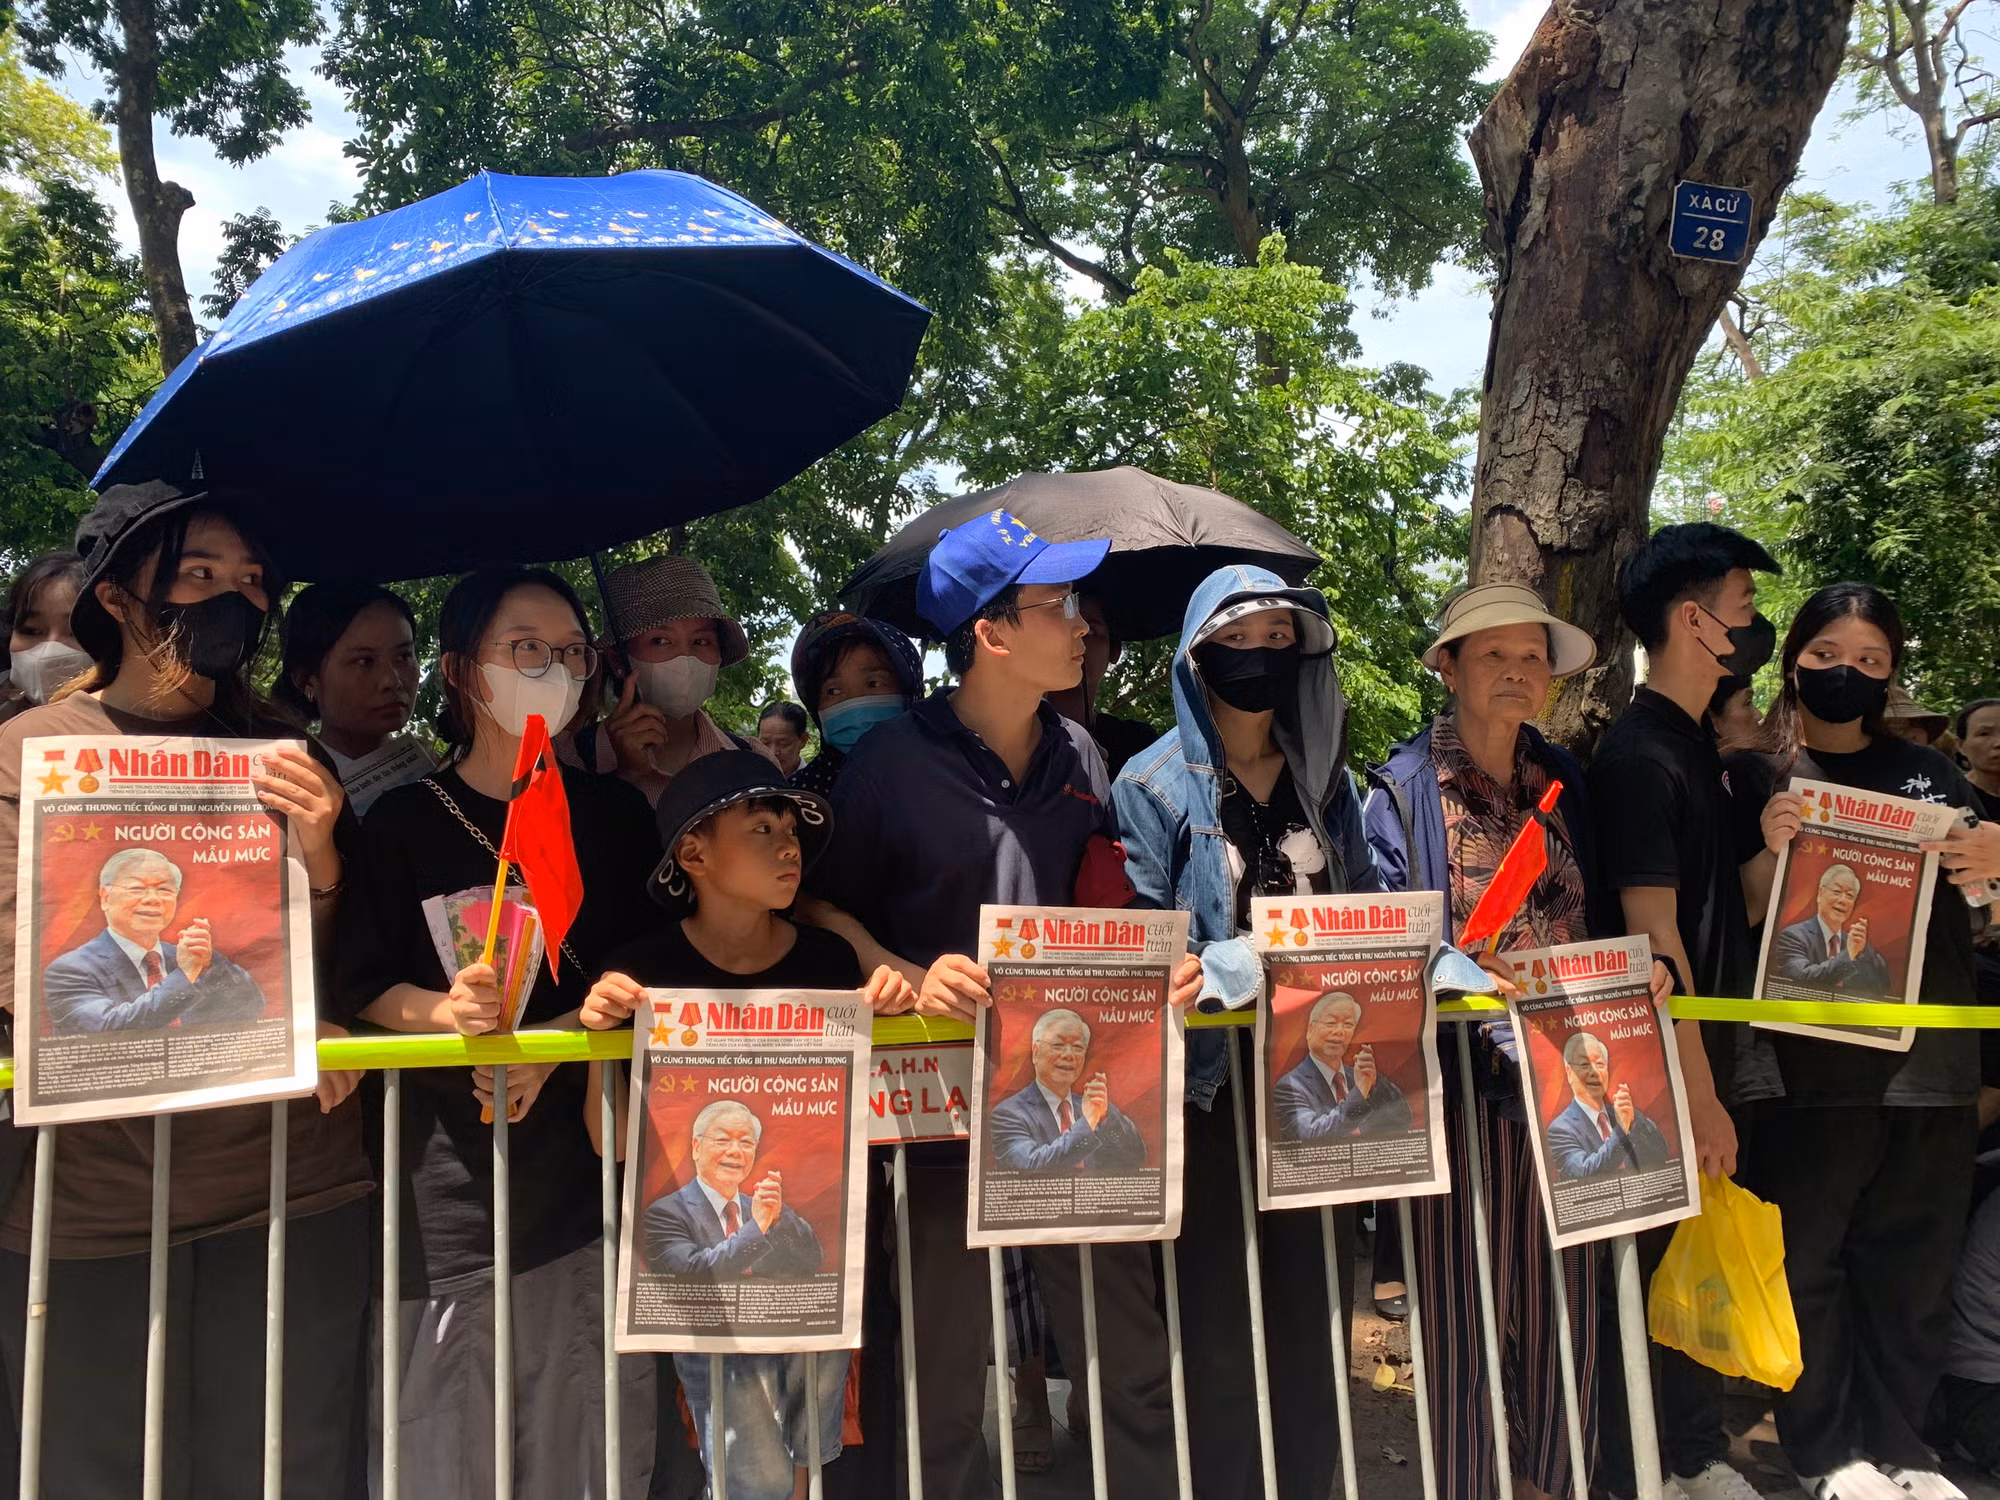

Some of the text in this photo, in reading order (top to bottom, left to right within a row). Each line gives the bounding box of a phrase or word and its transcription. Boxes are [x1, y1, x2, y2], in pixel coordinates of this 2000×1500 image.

[1689, 190, 1740, 213] XÀ CỪ
[1693, 226, 1725, 251] 28
[109, 748, 188, 777] Nhân
[193, 750, 249, 778] Dân
[42, 803, 55, 813] VÔ
[57, 803, 82, 812] CÙNG
[84, 804, 121, 812] THƯƠNG
[123, 802, 142, 812] TIẾC
[143, 802, 166, 812] TỔNG
[168, 802, 178, 812] BÍ
[179, 804, 196, 812] THƯ
[198, 802, 232, 812] NGUYỄN
[233, 802, 250, 812] PHÚ
[1834, 794, 1916, 828] Nhân Dân
[1916, 811, 1940, 824] cuối
[114, 820, 270, 843] NGƯỜI CỘNG SẢN
[1911, 821, 1935, 837] tuần
[192, 845, 271, 864] MẪU MỰC
[1832, 847, 1916, 872] NGƯỜI CỘNG SẢN
[1889, 875, 1912, 888] MỰC
[1312, 905, 1406, 931] Nhân Dân
[1408, 902, 1430, 918] cuối
[1043, 918, 1145, 946] Nhân Dân
[1147, 921, 1174, 936] cuối
[1408, 921, 1430, 934] tuần
[1145, 938, 1172, 953] tuần
[1628, 944, 1644, 960] cuối
[994, 966, 1004, 974] VÔ
[1004, 966, 1024, 976] CÙNG
[1024, 968, 1050, 976] THƯƠNG
[1052, 966, 1066, 976] TIẾC
[1066, 966, 1083, 976] TỔNG
[1084, 968, 1091, 976] BÍ
[1106, 968, 1130, 977] NGUYỄN
[1130, 968, 1144, 977] PHÚ
[1145, 970, 1164, 978] TRỌNG
[1548, 949, 1628, 979] Nhân Dân
[1629, 960, 1649, 974] tuần
[1321, 964, 1420, 987] NGƯỜI CỘNG SẢN
[1044, 984, 1156, 1004] NGƯỜI CỘNG SẢN
[1396, 987, 1419, 1002] MỰC
[706, 1002, 824, 1031] Nhân Dân
[826, 1003, 857, 1019] cuối
[1098, 1006, 1155, 1024] MẪU MỰC
[1564, 1002, 1649, 1029] NGƯỜI CỘNG SẢN
[825, 1021, 855, 1037] tuần
[1610, 1022, 1653, 1041] MẪU MỰC
[650, 1054, 847, 1066] VÔ CÙNG THƯƠNG TIẾC TỔNG BÍ THƯ NGUYỄN PHÚ TRỌNG
[707, 1072, 839, 1095] NGƯỜI CỘNG SẢN
[771, 1097, 838, 1118] MẪU MỰC
